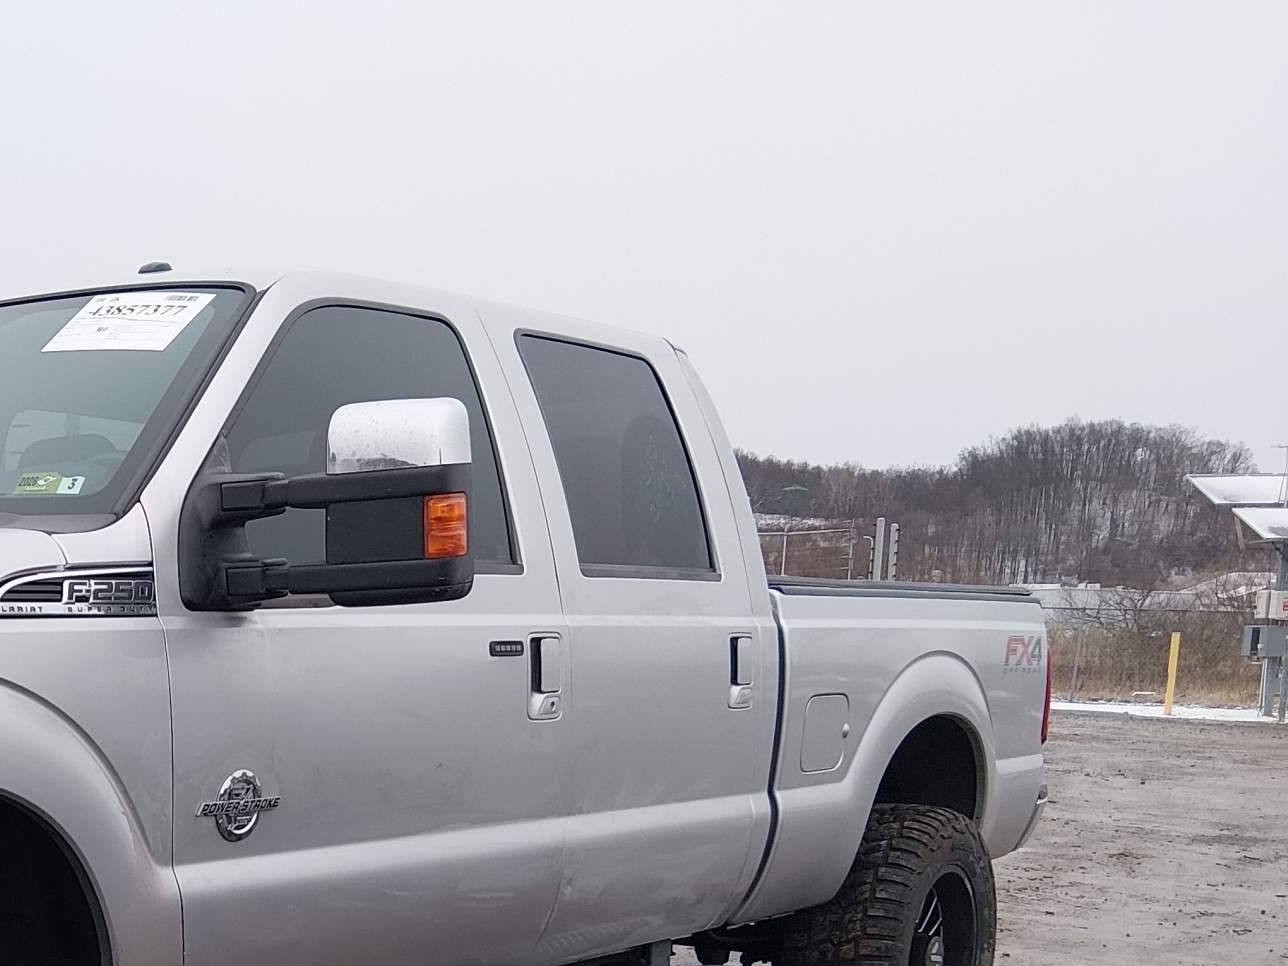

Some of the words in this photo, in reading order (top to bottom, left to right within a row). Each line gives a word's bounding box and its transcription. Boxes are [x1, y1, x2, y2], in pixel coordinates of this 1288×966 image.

[88, 304, 189, 317] 43857377
[67, 478, 78, 490] 3
[64, 580, 154, 603] F-250
[1004, 635, 1042, 666] FX4
